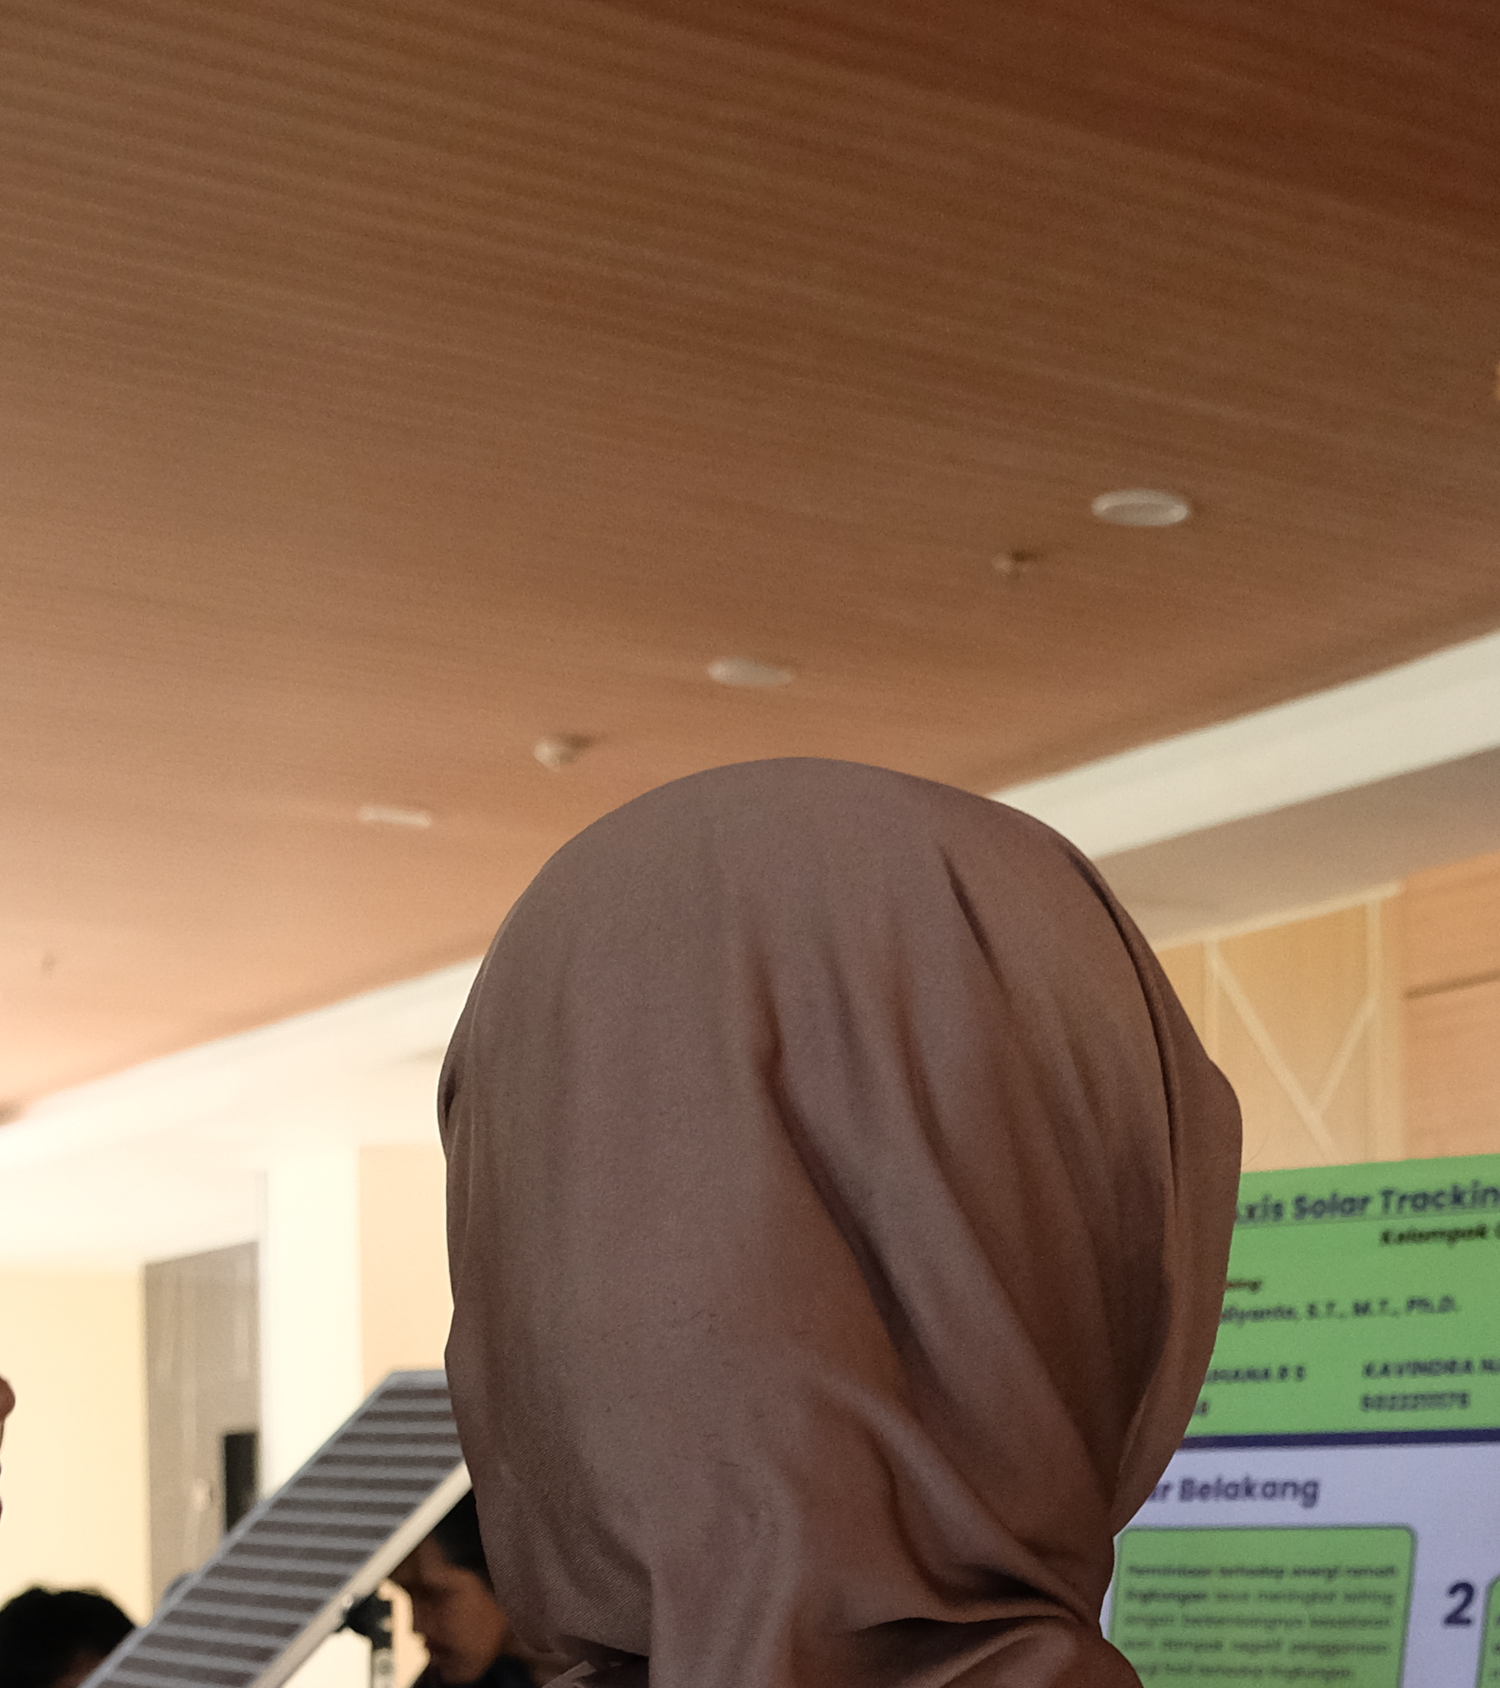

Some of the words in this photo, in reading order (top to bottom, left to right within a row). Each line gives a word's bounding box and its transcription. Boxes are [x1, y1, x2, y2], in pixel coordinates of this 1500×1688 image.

[1237, 1193, 1283, 1223] xis
[1294, 1191, 1371, 1221] Solar
[1178, 1474, 1321, 1509] Belakang
[1443, 1582, 1474, 1626] 2
